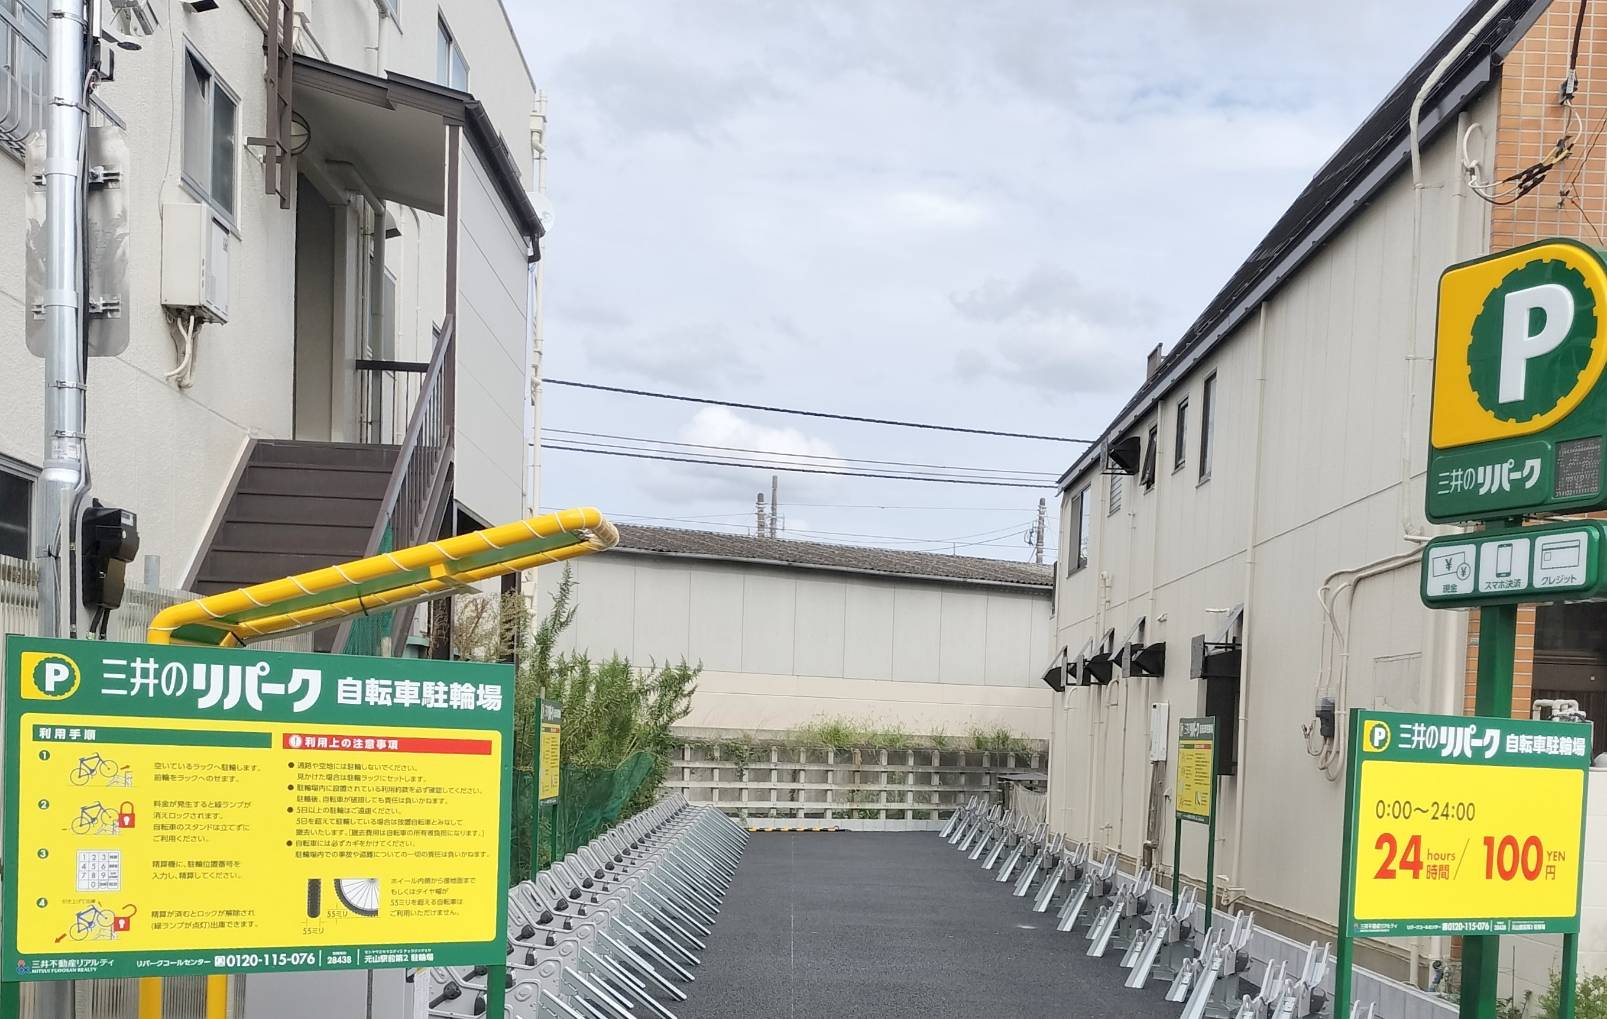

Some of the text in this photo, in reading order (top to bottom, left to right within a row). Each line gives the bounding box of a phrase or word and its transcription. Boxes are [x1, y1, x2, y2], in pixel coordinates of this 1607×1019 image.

[1499, 284, 1574, 403] P
[1438, 458, 1541, 495] 三井のリパーク
[1484, 578, 1521, 590] スマホ決済
[1541, 574, 1576, 585] クレジット
[1442, 584, 1458, 593] 現金
[45, 662, 69, 691] P
[101, 656, 502, 712] 三井のリパーク 自転車駐輪場
[39, 727, 96, 740] 利用手順
[1374, 726, 1386, 746] P
[304, 736, 399, 750] 利用上の注意事項
[1398, 723, 1585, 759] 三井のリパーク 自転車駐輪場
[154, 762, 261, 772] 空いているラックへ駐輪します。
[154, 774, 239, 782] 前輪をラックへのせます。
[153, 800, 252, 809] 料金が発生すると緑ランプが
[153, 812, 223, 820] 消えロックされます。
[153, 823, 250, 831] 自転車のスタンドは立てずに
[153, 835, 209, 843] ご利用ください。
[1373, 832, 1423, 880] 24
[1427, 848, 1456, 861] hours
[1483, 835, 1544, 881] 100
[1547, 851, 1565, 862] YEN
[152, 872, 241, 880] 入力し、精算してください。
[1426, 864, 1556, 880] 時間 円
[151, 910, 255, 918] 精算が済むとロックが解除され
[390, 909, 460, 917] ご利用いただけません。
[32, 959, 114, 969] 三井不動産リアルティ
[136, 960, 211, 968] リパークコールセンター
[227, 952, 316, 967] 0120-115-076
[327, 955, 352, 964] 28438
